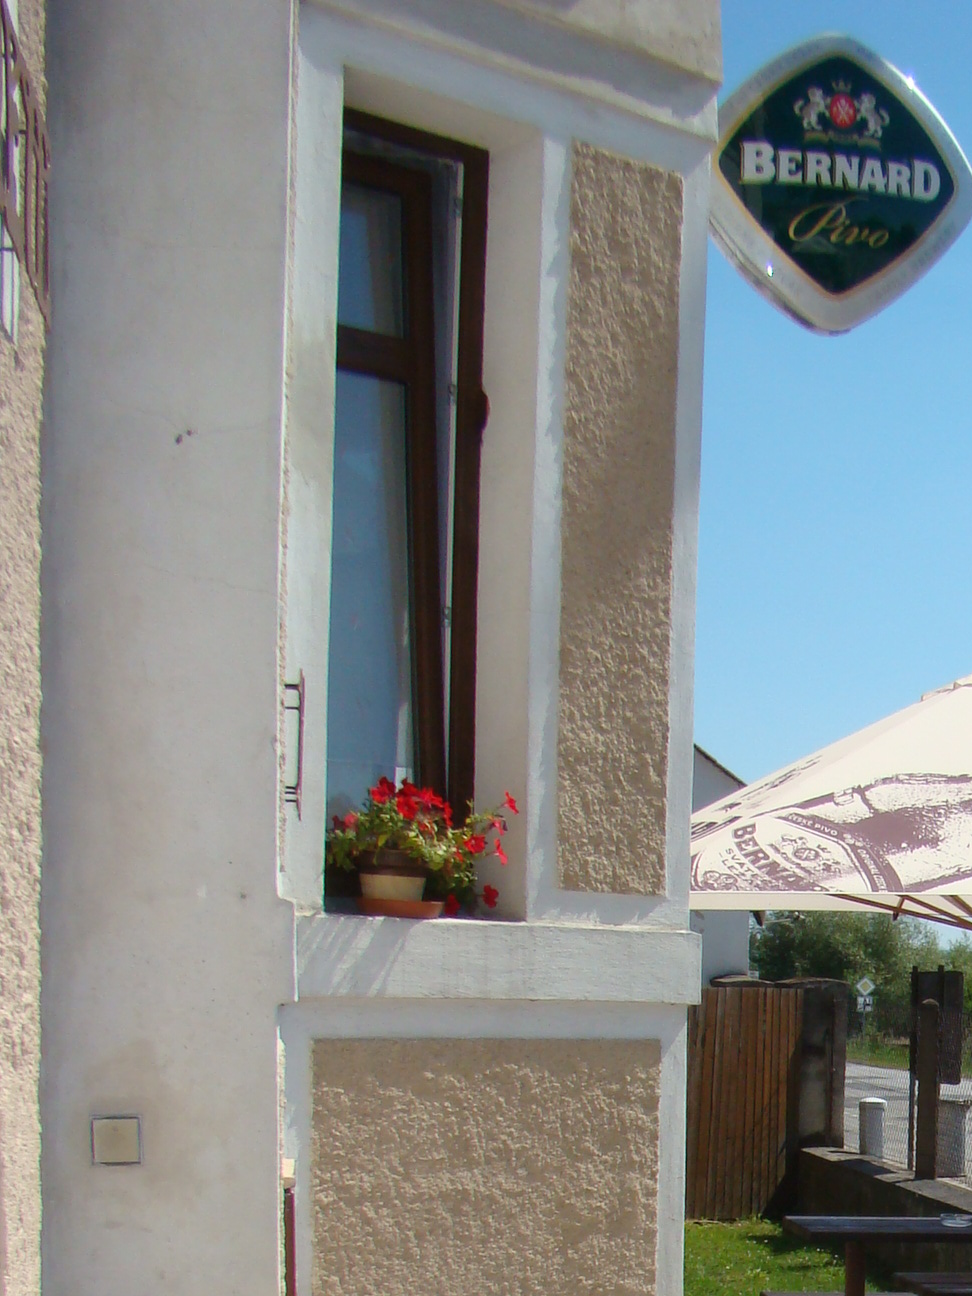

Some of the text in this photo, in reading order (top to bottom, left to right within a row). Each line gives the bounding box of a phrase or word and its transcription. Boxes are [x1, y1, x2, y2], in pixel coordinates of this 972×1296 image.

[740, 140, 941, 202] BERNARD
[788, 198, 889, 248] Pivo
[814, 822, 838, 837] PIVO
